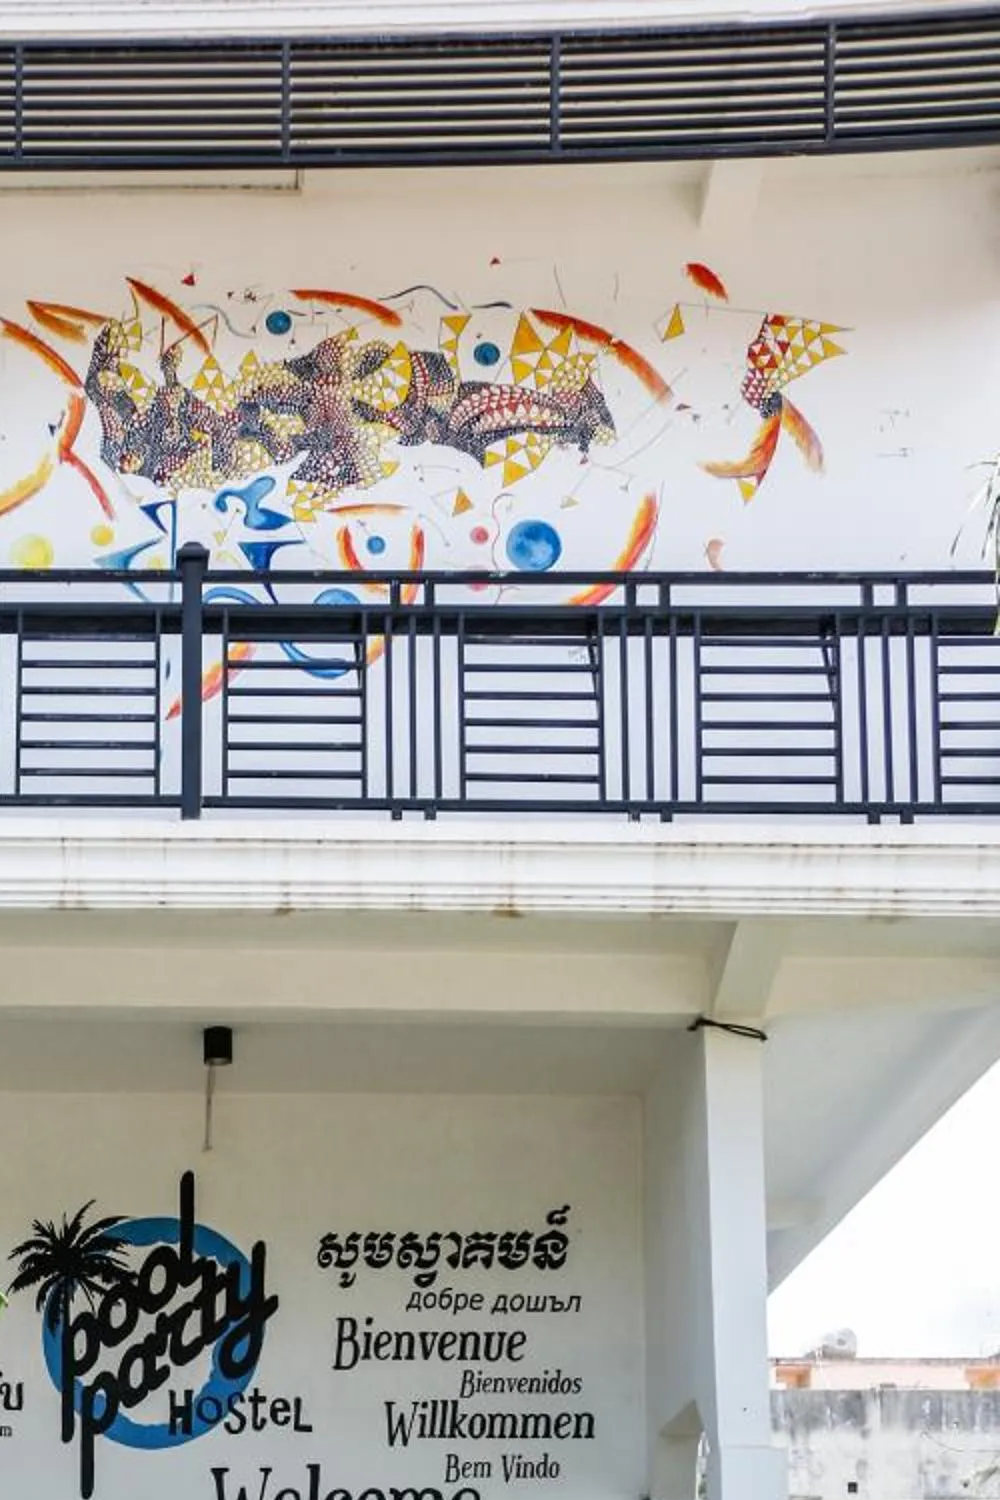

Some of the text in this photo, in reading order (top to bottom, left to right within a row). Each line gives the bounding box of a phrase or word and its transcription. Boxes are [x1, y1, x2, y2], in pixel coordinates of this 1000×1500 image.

[405, 1287, 582, 1315] добре дошъл
[332, 1316, 528, 1370] Bienvenue
[460, 1368, 583, 1399] Bienvenidos
[384, 1399, 596, 1447] Willkommen
[444, 1452, 560, 1484] Bem Vindo
